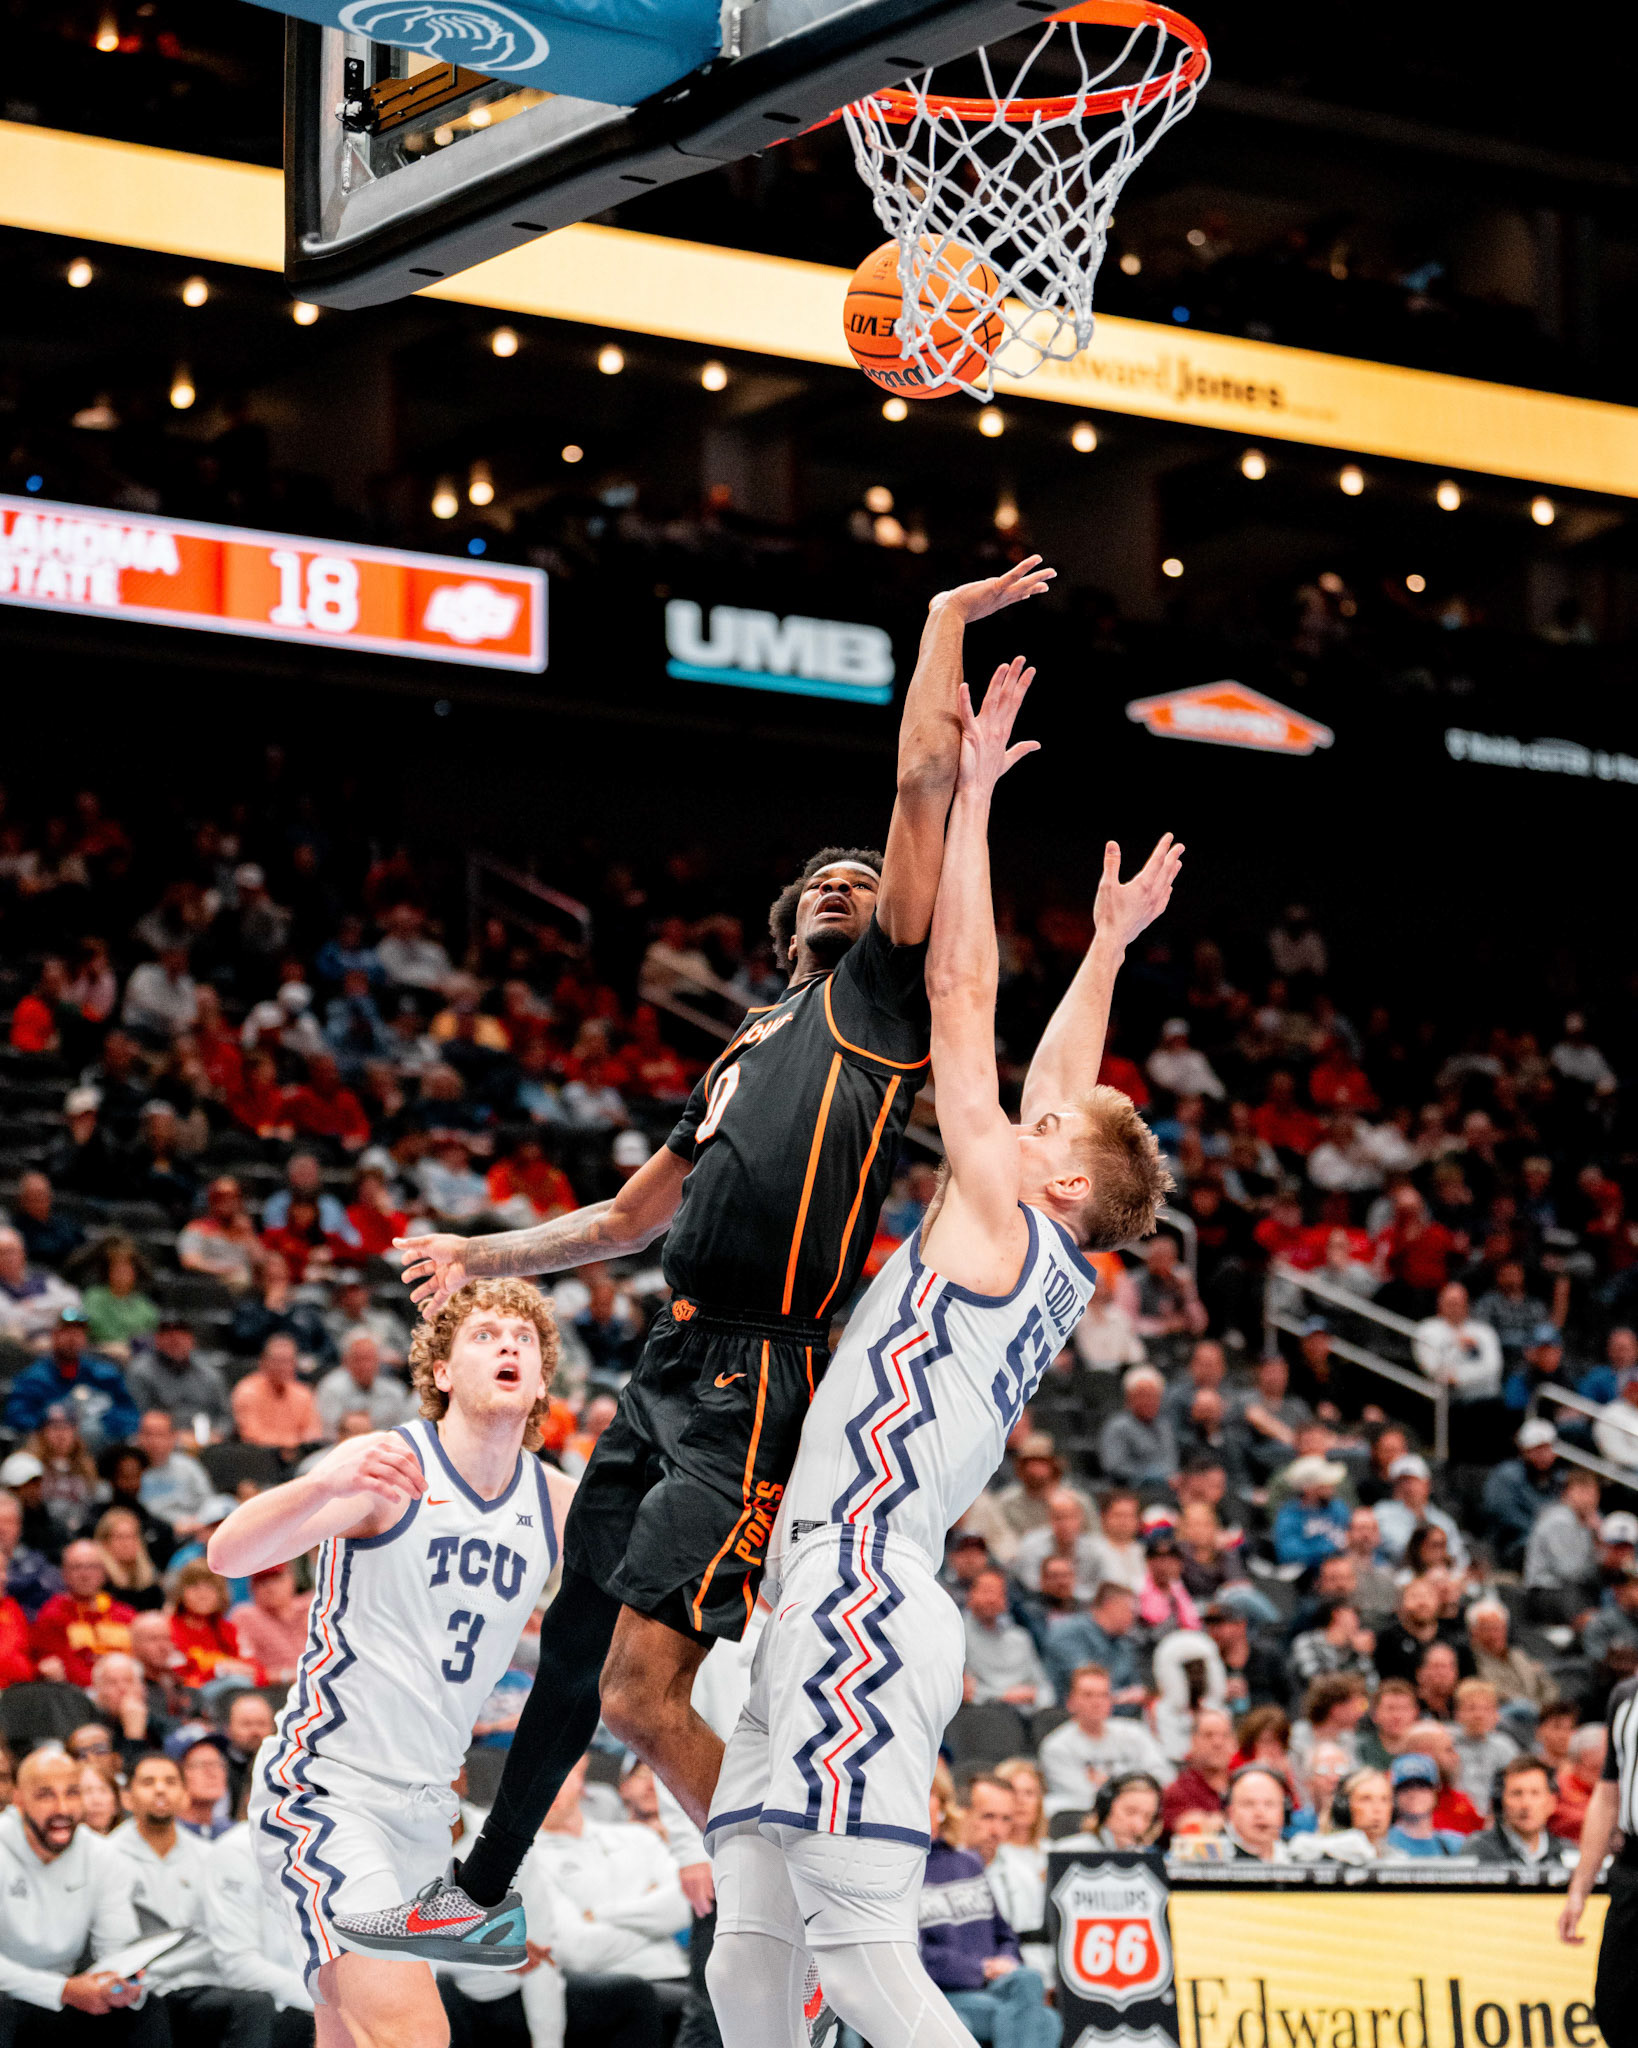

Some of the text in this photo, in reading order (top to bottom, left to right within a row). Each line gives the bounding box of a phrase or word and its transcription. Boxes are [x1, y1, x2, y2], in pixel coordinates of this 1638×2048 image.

[851, 313, 895, 337] EVO
[859, 363, 939, 389] Wilso
[1175, 355, 1286, 409] Jones
[269, 548, 360, 633] 18
[664, 598, 896, 687] UMB
[1042, 1252, 1085, 1338] TOOLS
[733, 1480, 784, 1567] POKES
[427, 1536, 527, 1602] TCU
[441, 1609, 486, 1685] 3
[1072, 1890, 1149, 1912] PHILLIPS
[1080, 1923, 1148, 1976] 66
[1182, 1977, 1597, 2048] Edward Jone
